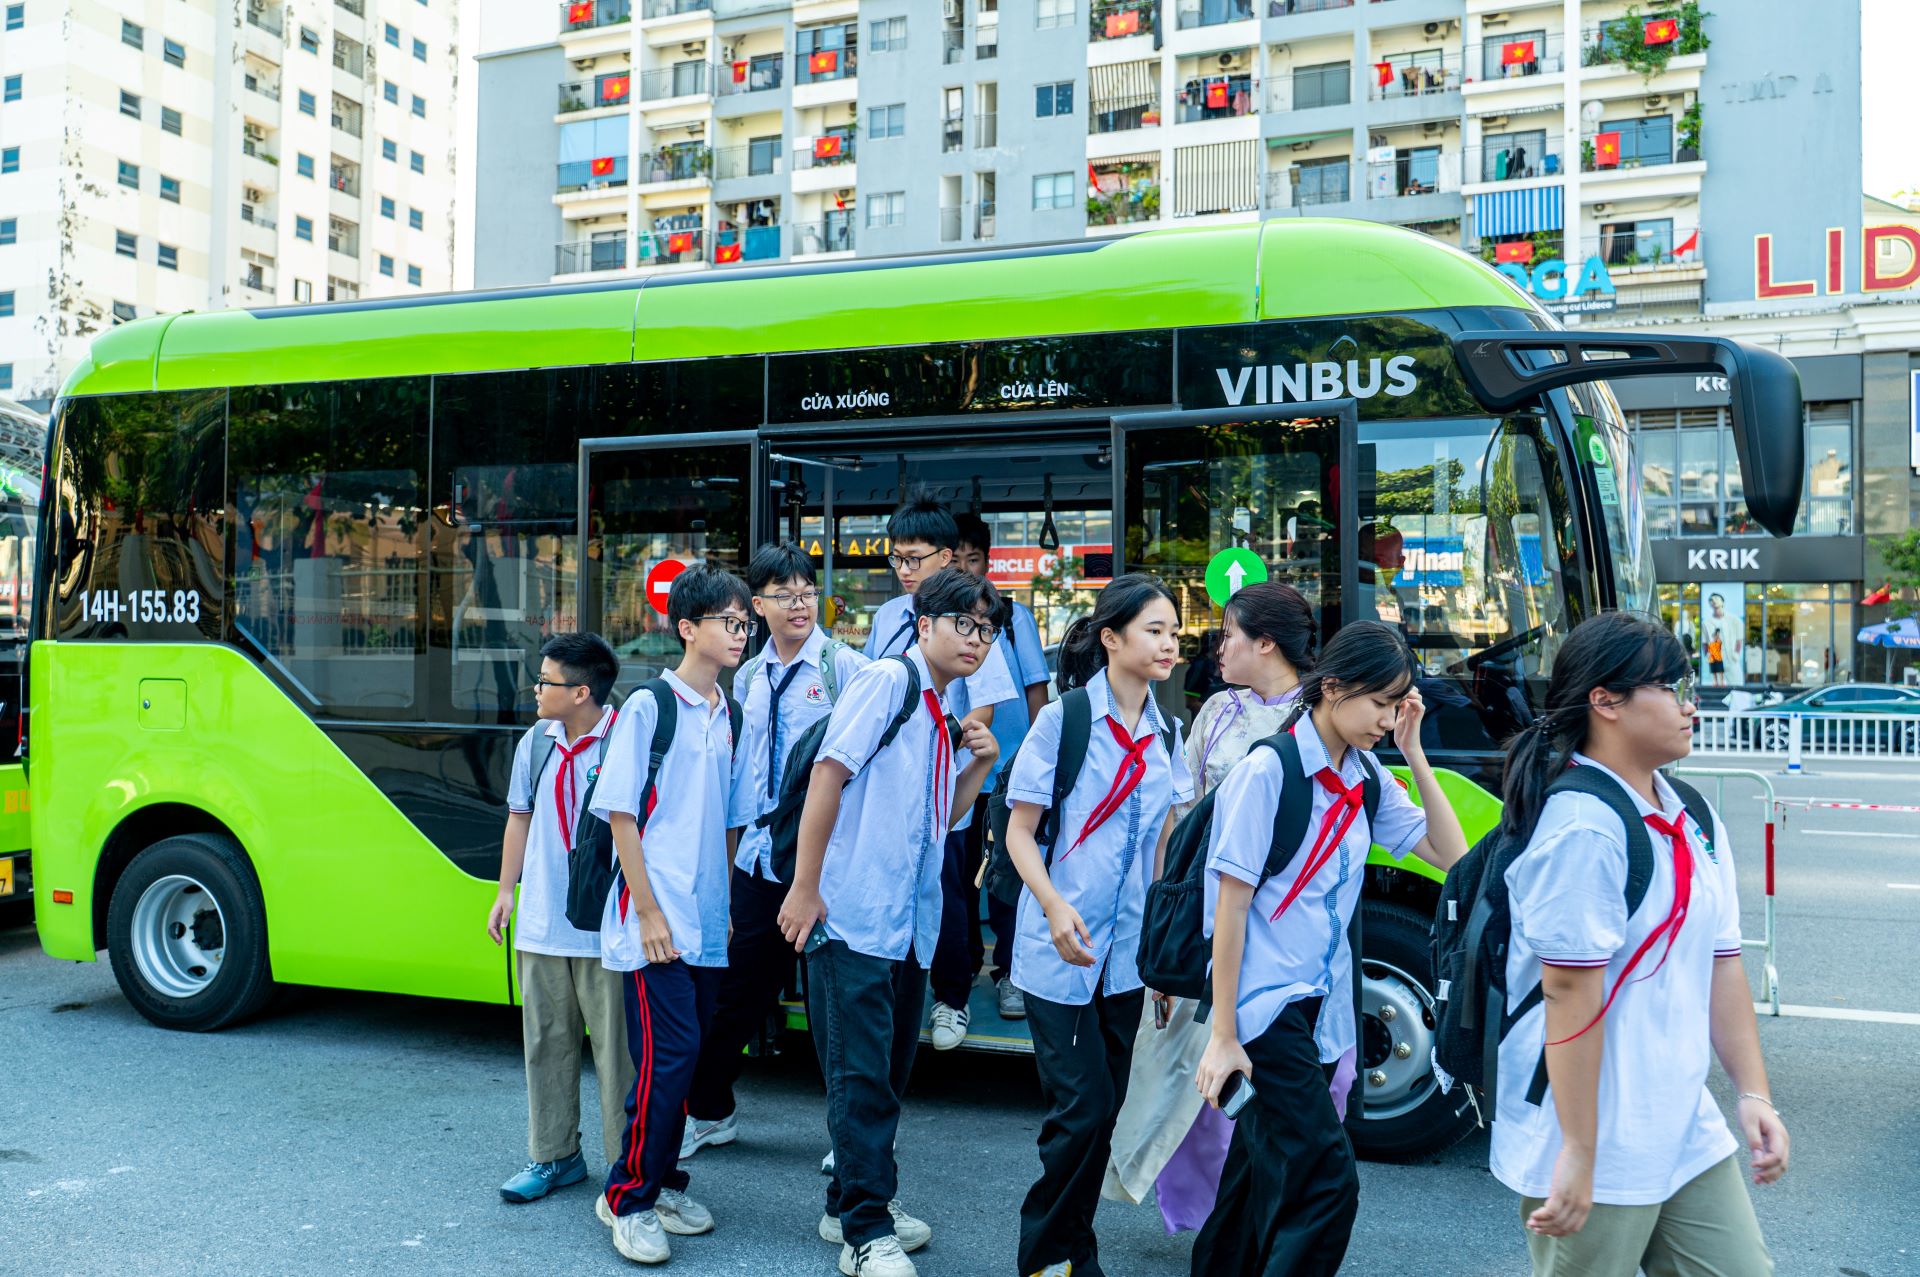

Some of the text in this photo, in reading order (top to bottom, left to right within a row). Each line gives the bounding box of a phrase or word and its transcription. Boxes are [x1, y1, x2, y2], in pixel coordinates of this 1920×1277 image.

[1001, 379, 1069, 399] CỬA LÊN
[1215, 355, 1417, 406] VINBUS
[1695, 376, 1730, 392] KR
[801, 389, 890, 411] CỬA XUỐNG
[1688, 548, 1760, 570] KRIK
[80, 589, 200, 623] 14H-155.83
[4, 789, 31, 813] BU
